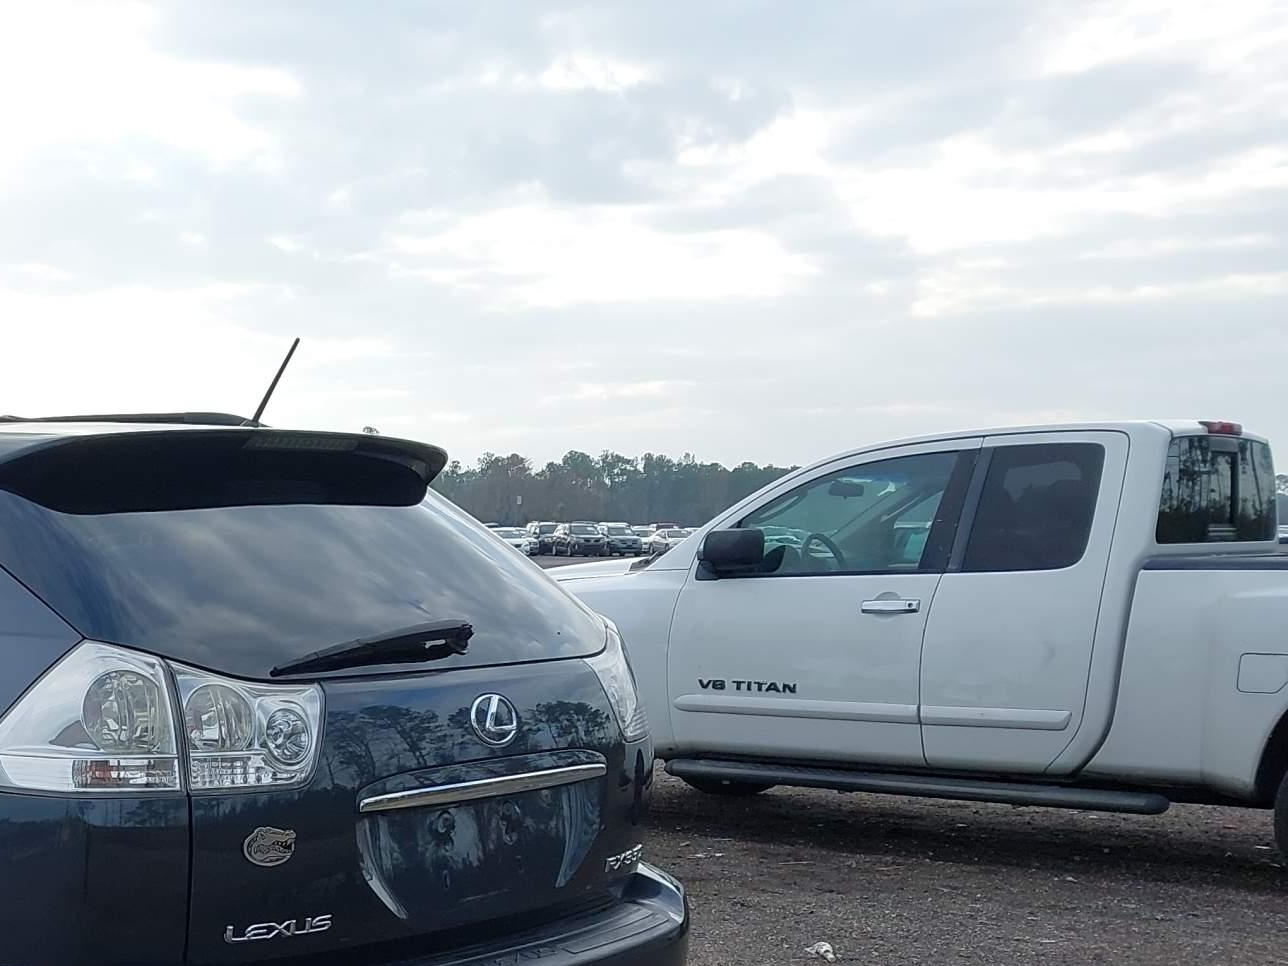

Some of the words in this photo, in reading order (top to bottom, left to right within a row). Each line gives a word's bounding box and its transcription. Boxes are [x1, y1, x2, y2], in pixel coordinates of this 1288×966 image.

[698, 679, 726, 690] V8
[732, 680, 797, 694] TITAN
[224, 910, 332, 944] LEXUS
